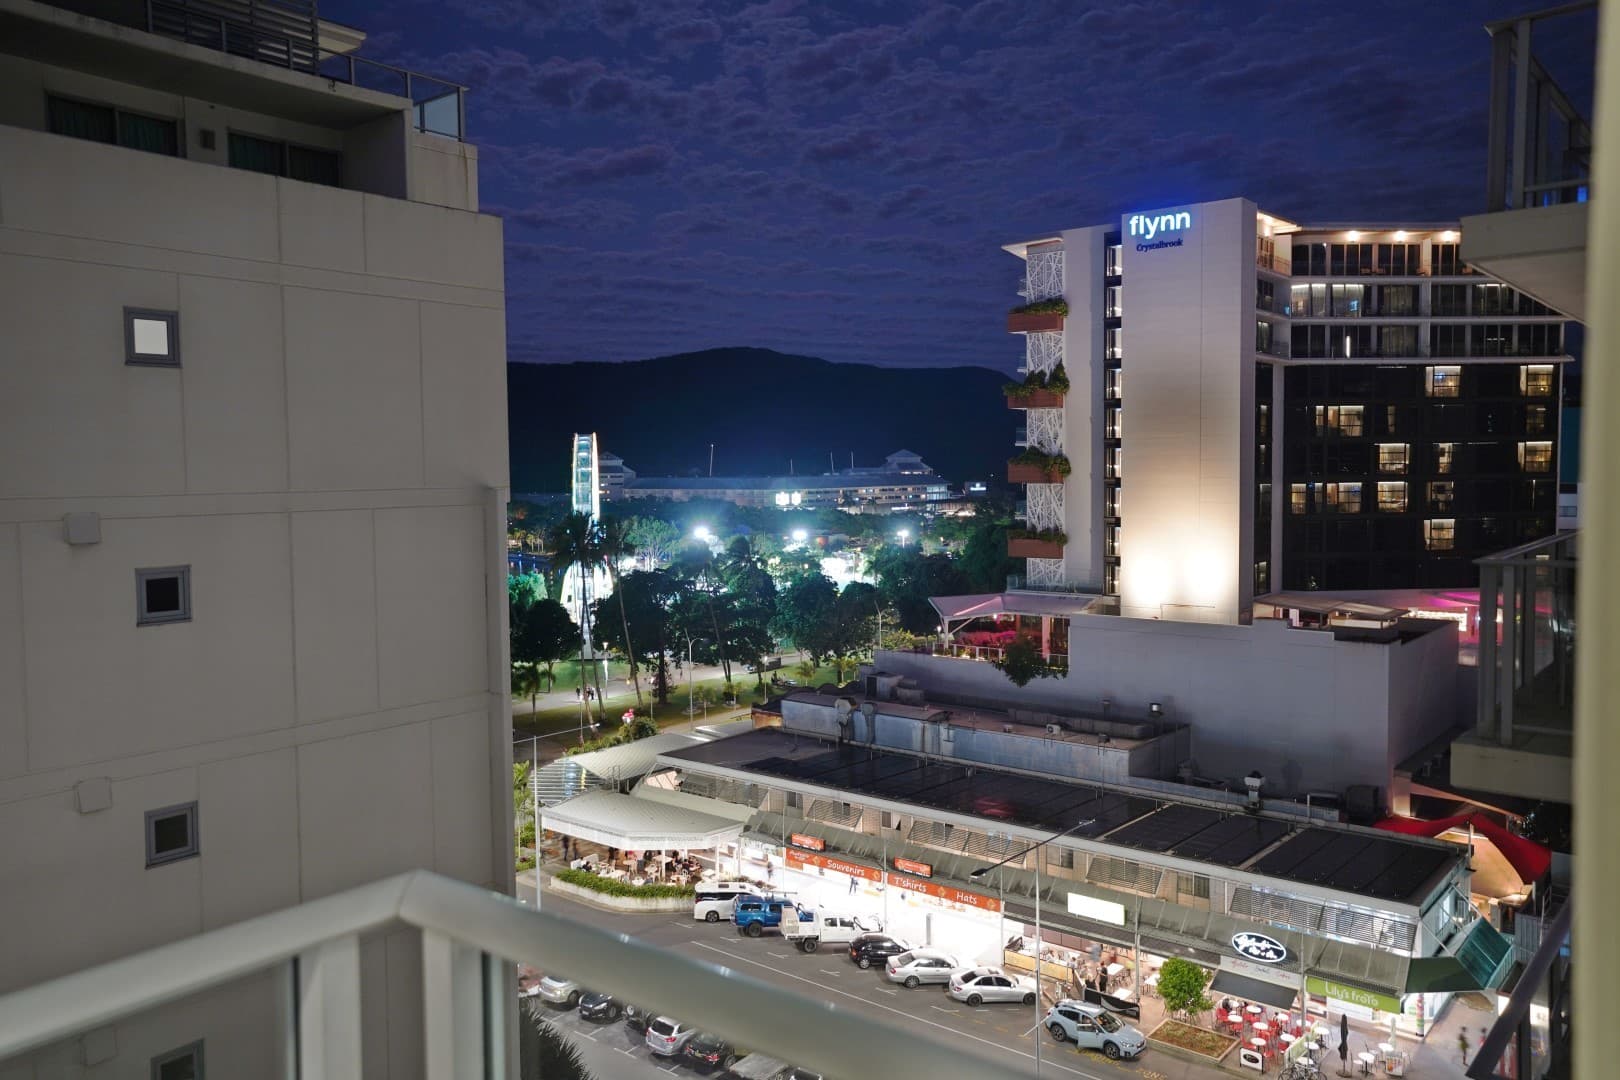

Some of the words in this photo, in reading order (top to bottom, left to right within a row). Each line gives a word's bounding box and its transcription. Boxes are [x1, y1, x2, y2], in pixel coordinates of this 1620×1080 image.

[1129, 211, 1191, 239] flynn
[1136, 238, 1183, 253] Crystalbrook
[827, 859, 865, 877] Souvenirs
[894, 876, 927, 893] T'shirts
[956, 891, 977, 905] Hats
[1325, 981, 1350, 1000] Lily's
